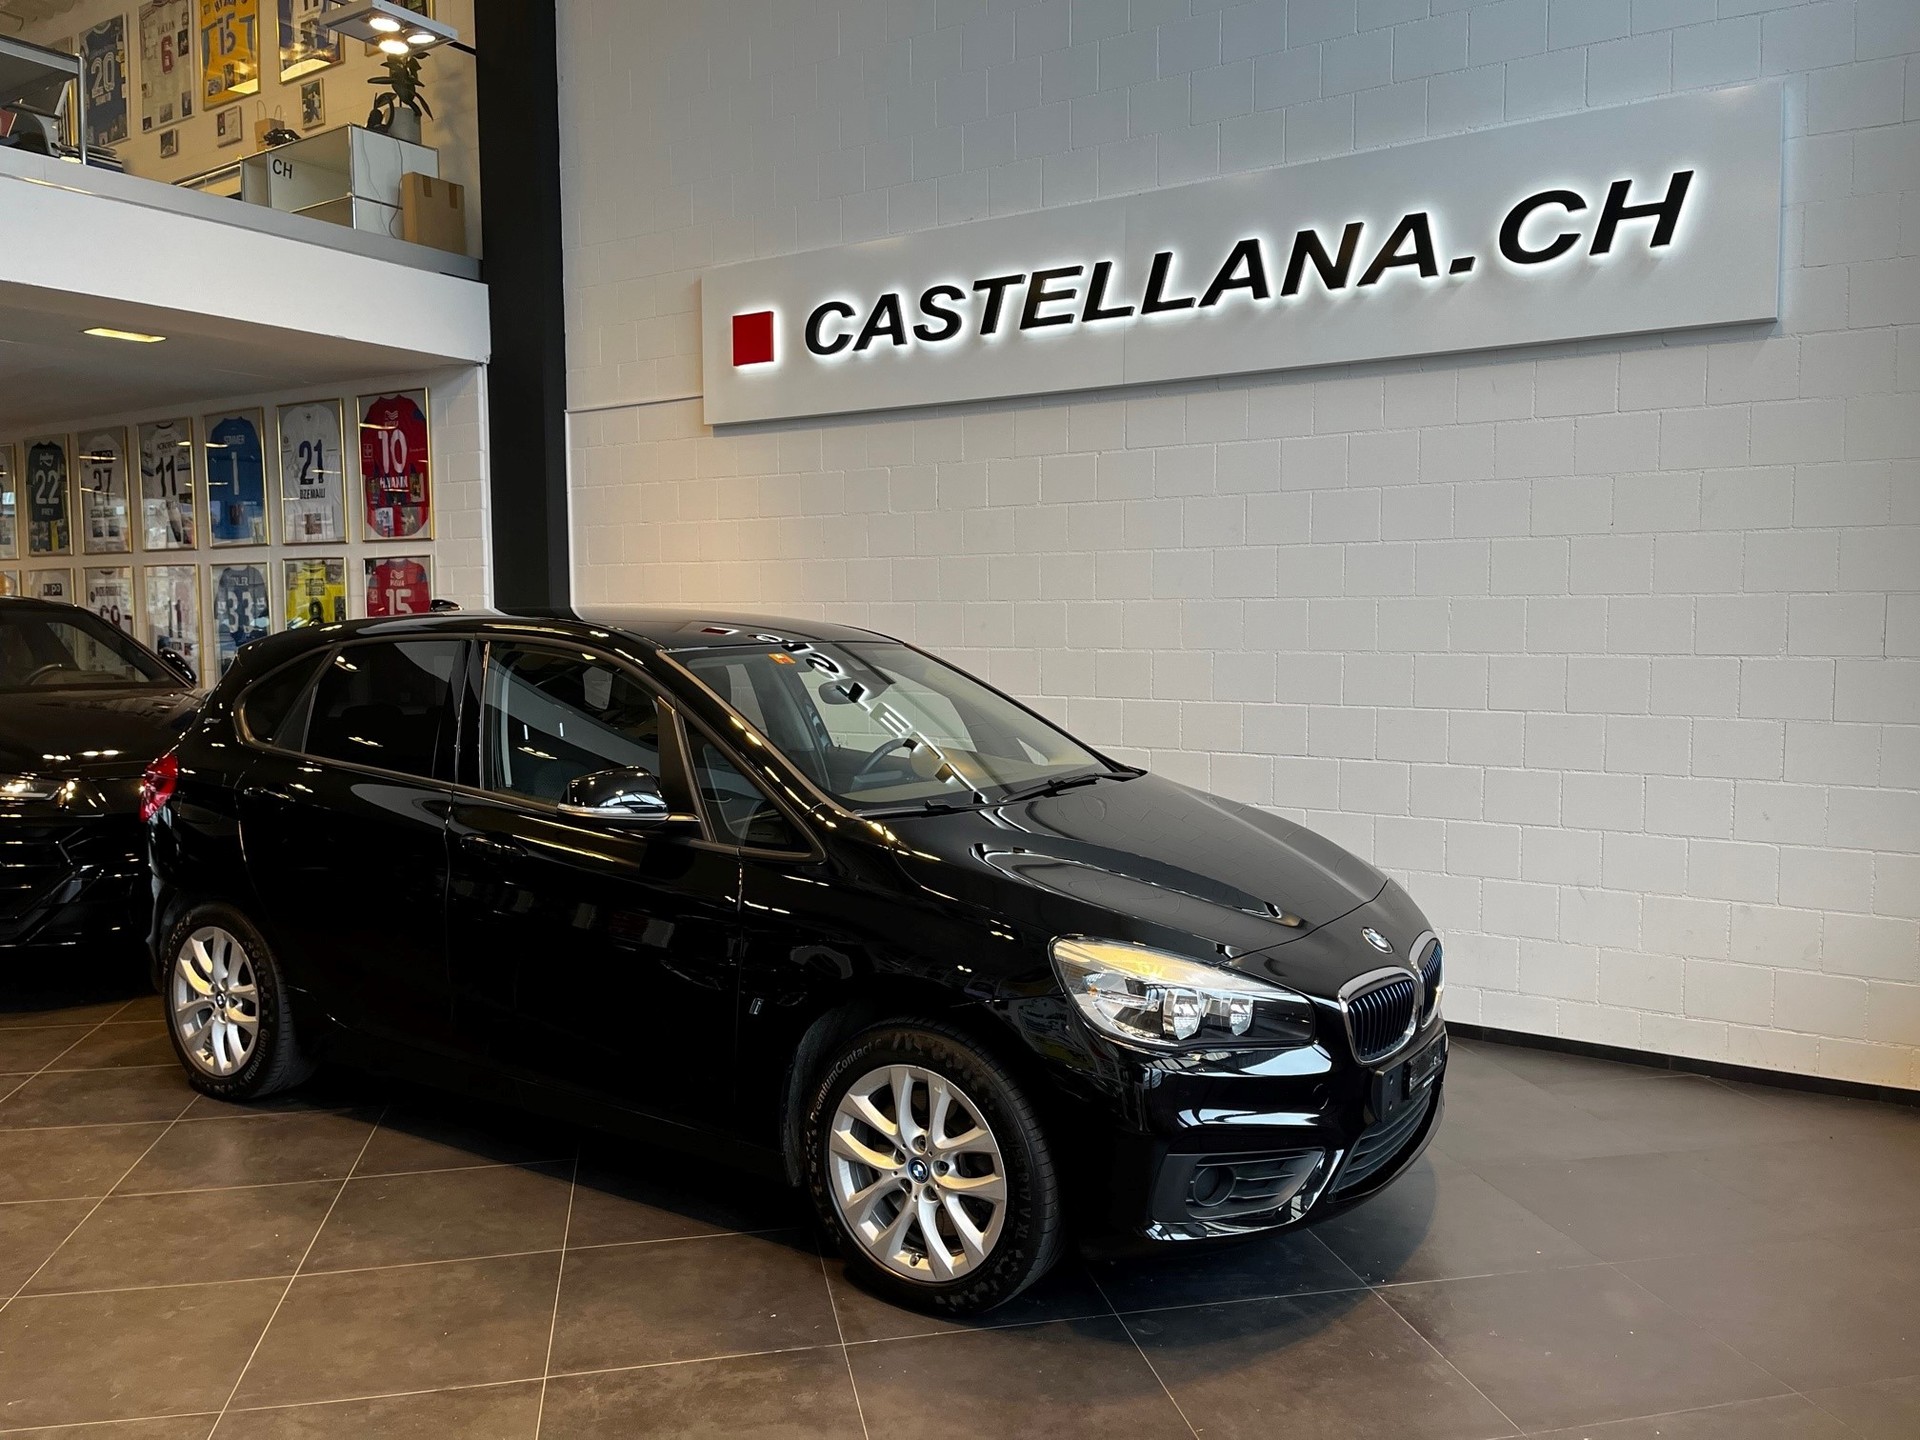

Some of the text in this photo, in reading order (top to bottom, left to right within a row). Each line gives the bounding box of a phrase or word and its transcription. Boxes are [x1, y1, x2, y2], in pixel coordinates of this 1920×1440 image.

[91, 52, 115, 98] 20
[161, 35, 174, 74] 6
[272, 158, 293, 179] CH
[231, 451, 240, 495] 1
[299, 439, 324, 485] 21
[378, 429, 408, 474] 10
[35, 469, 60, 505] 22
[155, 455, 177, 497] 11
[227, 591, 254, 634] 33
[385, 588, 413, 614] 15
[810, 1041, 873, 1124] PremiumContact
